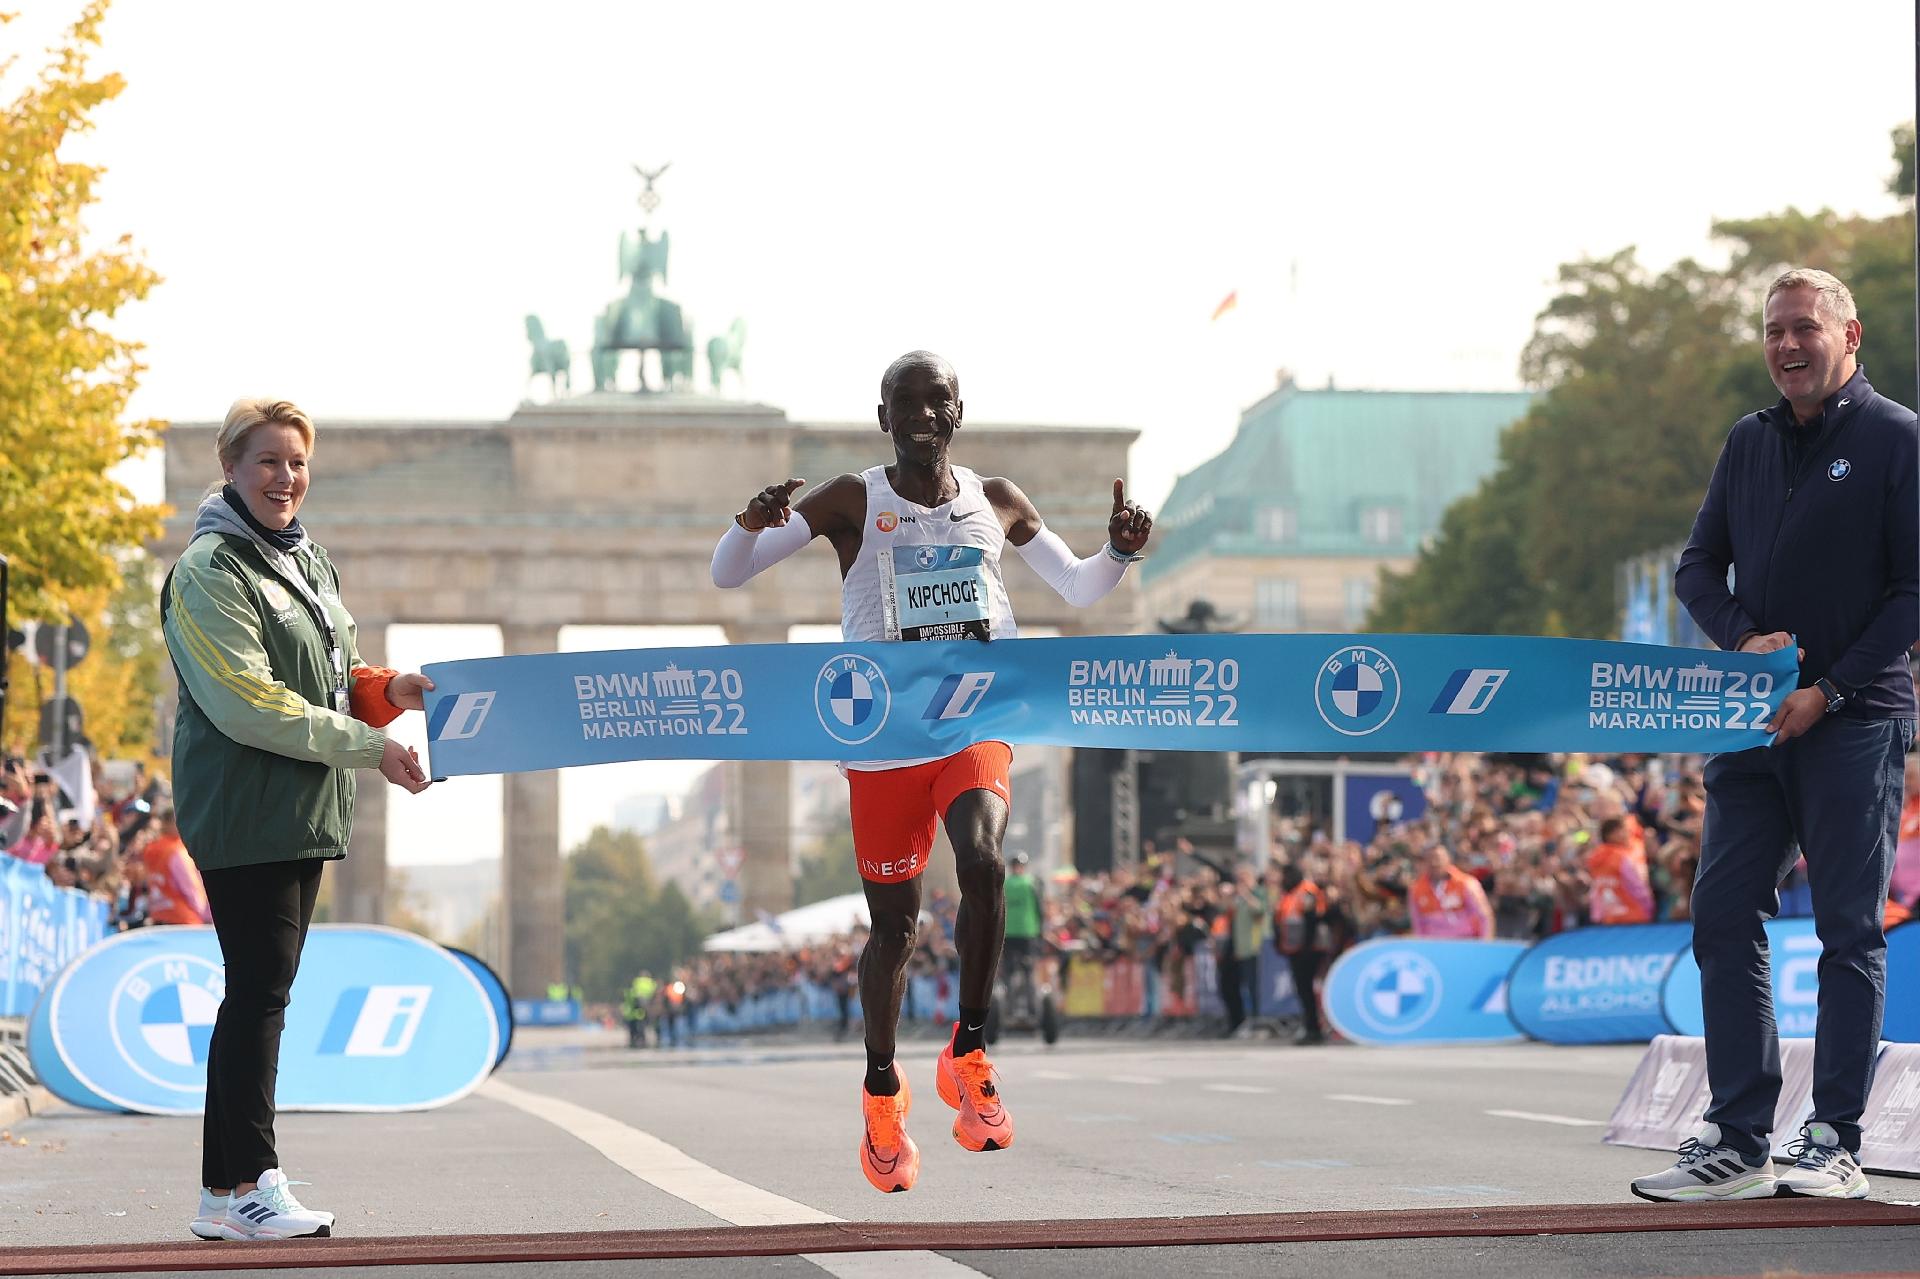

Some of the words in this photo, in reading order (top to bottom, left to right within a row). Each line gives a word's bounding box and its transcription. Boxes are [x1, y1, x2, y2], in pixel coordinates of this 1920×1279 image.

[900, 516, 916, 524] NN
[907, 579, 979, 609] KIPCHOGE
[919, 623, 965, 638] IMPOSSIBLE
[823, 658, 879, 683] BMW
[1069, 660, 1146, 686] BMW
[1194, 658, 1239, 691] 20
[1328, 650, 1390, 675] BMW
[573, 672, 648, 701] BMW
[700, 669, 743, 700] 20
[1590, 662, 1673, 691] BMW
[1724, 671, 1774, 699] 20
[579, 699, 656, 720] BERLIN
[1069, 689, 1145, 706] BERLIN
[1590, 691, 1672, 710] BERLIN
[582, 718, 702, 740] MARATHON
[706, 703, 748, 735] 22
[1071, 709, 1192, 727] MARATHON
[1195, 694, 1239, 726] 22
[1589, 711, 1721, 730] MARATHON
[1725, 701, 1771, 731] 22
[862, 854, 918, 876] INEOS
